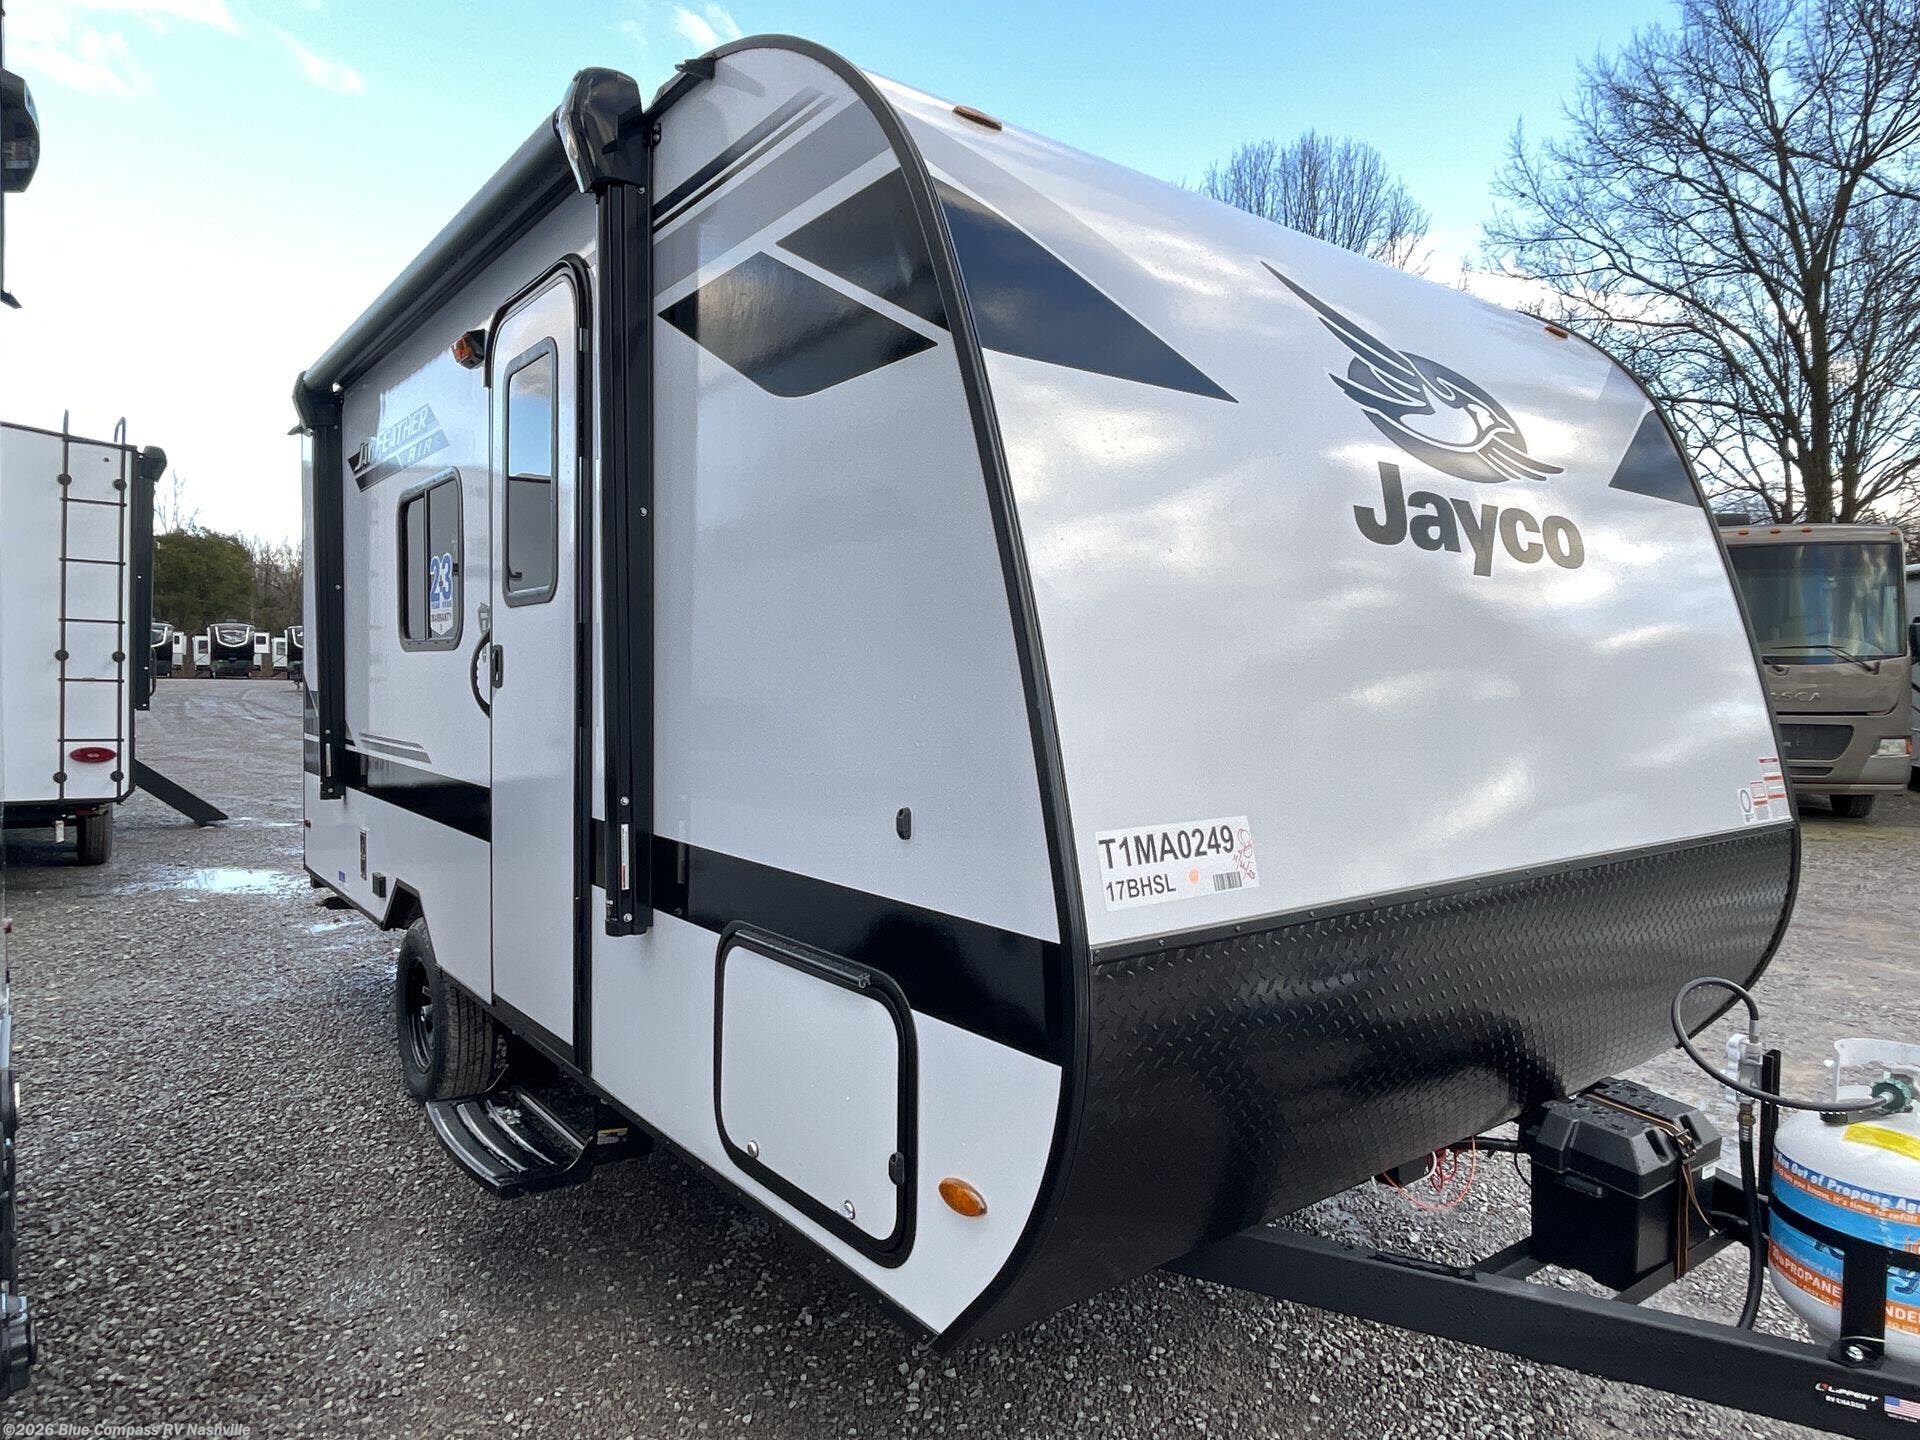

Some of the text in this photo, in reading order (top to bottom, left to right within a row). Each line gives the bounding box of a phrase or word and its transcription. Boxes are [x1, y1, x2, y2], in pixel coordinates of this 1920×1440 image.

[1353, 461, 1585, 577] Jayco
[1098, 825, 1234, 869] T1MA0249
[1106, 874, 1176, 901] 17BHSL
[1791, 1163, 1808, 1179] Out
[1811, 1174, 1825, 1187] of
[1827, 1179, 1890, 1209] Propane
[1785, 1258, 1842, 1299] PROPANE
